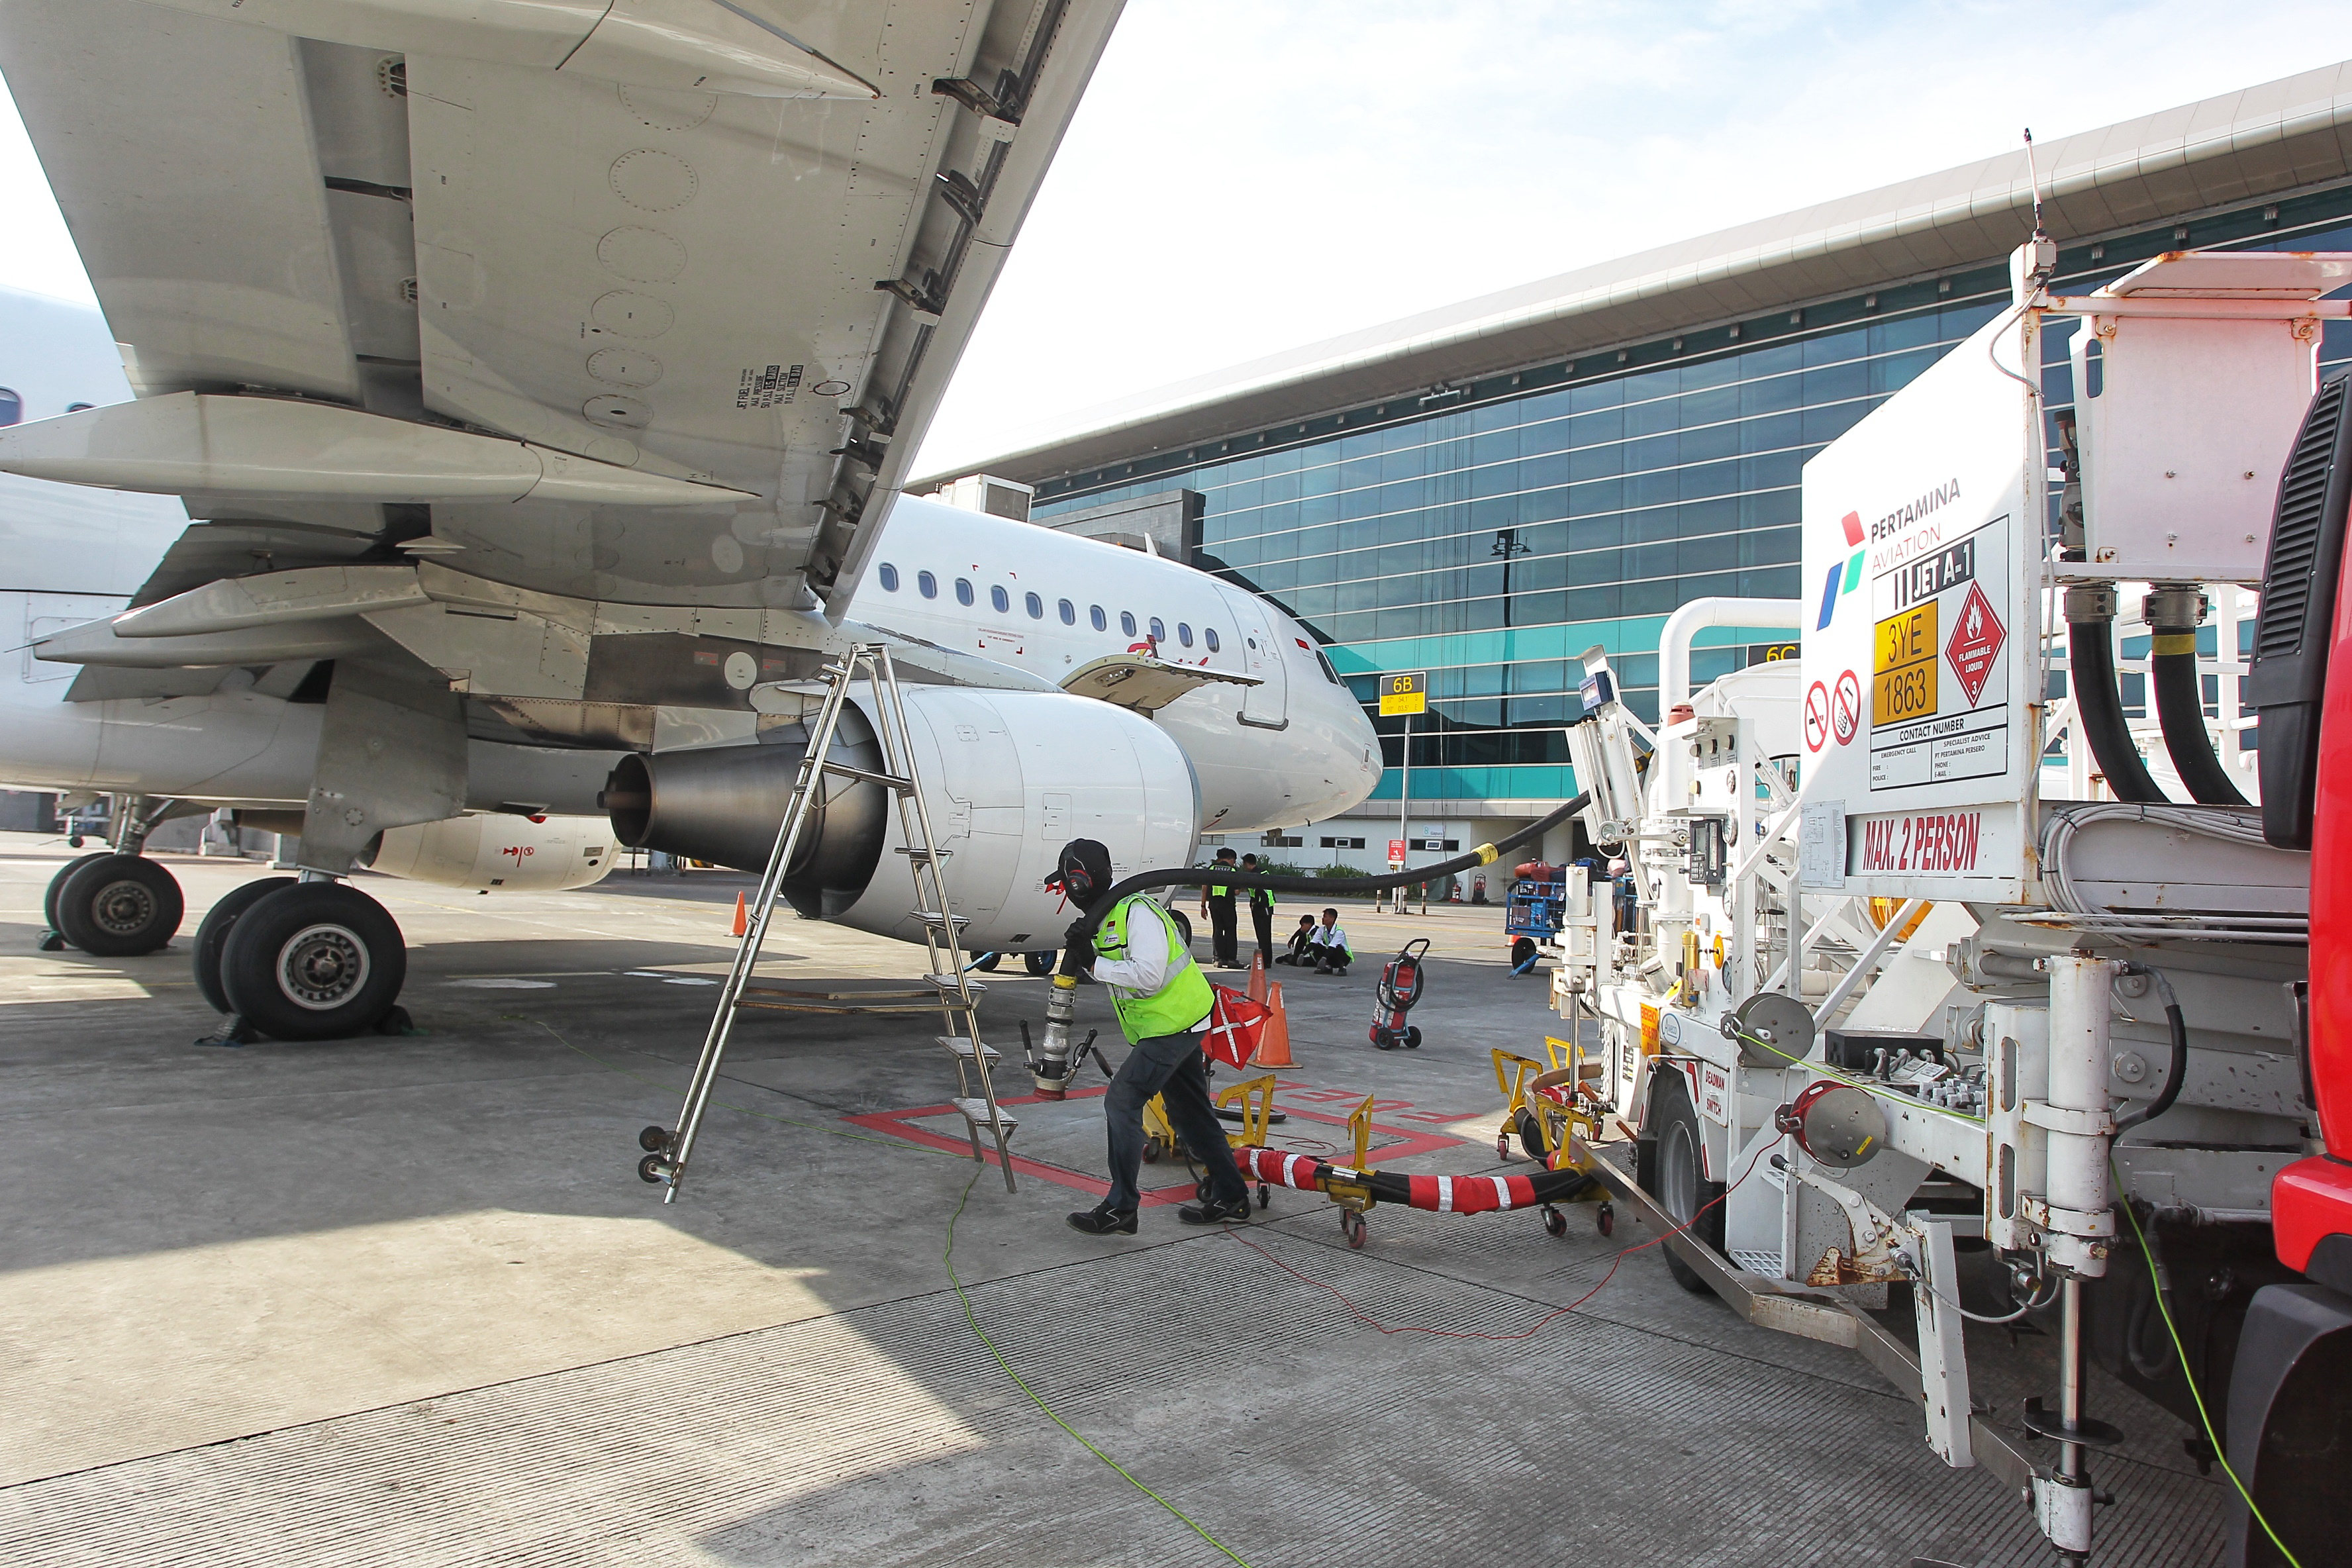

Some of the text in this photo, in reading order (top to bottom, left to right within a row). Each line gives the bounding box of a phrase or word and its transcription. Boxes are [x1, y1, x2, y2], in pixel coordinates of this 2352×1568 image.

[738, 388, 750, 400] FUEL
[1871, 477, 1961, 544] PERTAMINA
[1872, 522, 1941, 573] AVIATION
[1913, 542, 1971, 599] JET A-1
[1888, 612, 1922, 663] 3YE
[1766, 646, 1796, 663] 6C
[1958, 644, 1991, 663] FLAMMABLE
[1965, 660, 1983, 673] LIQUID
[1393, 676, 1413, 693] 6B
[1884, 667, 1926, 716] 1863
[1971, 680, 1977, 695] 3
[1899, 718, 1965, 742] CONTACT NUMBER
[1943, 733, 1991, 748] SPECIALIST ADVICE
[1881, 749, 1906, 759] EMERGENCY
[1940, 748, 1965, 758] PERTAMINA
[1862, 819, 1896, 871] MAX.
[1898, 817, 1912, 871] 2
[1912, 812, 1981, 871] PERSON
[1705, 1069, 1725, 1091] DEADMAN
[1256, 1079, 1485, 1124] FUEL
[1706, 1097, 1722, 1118] SWITCH
